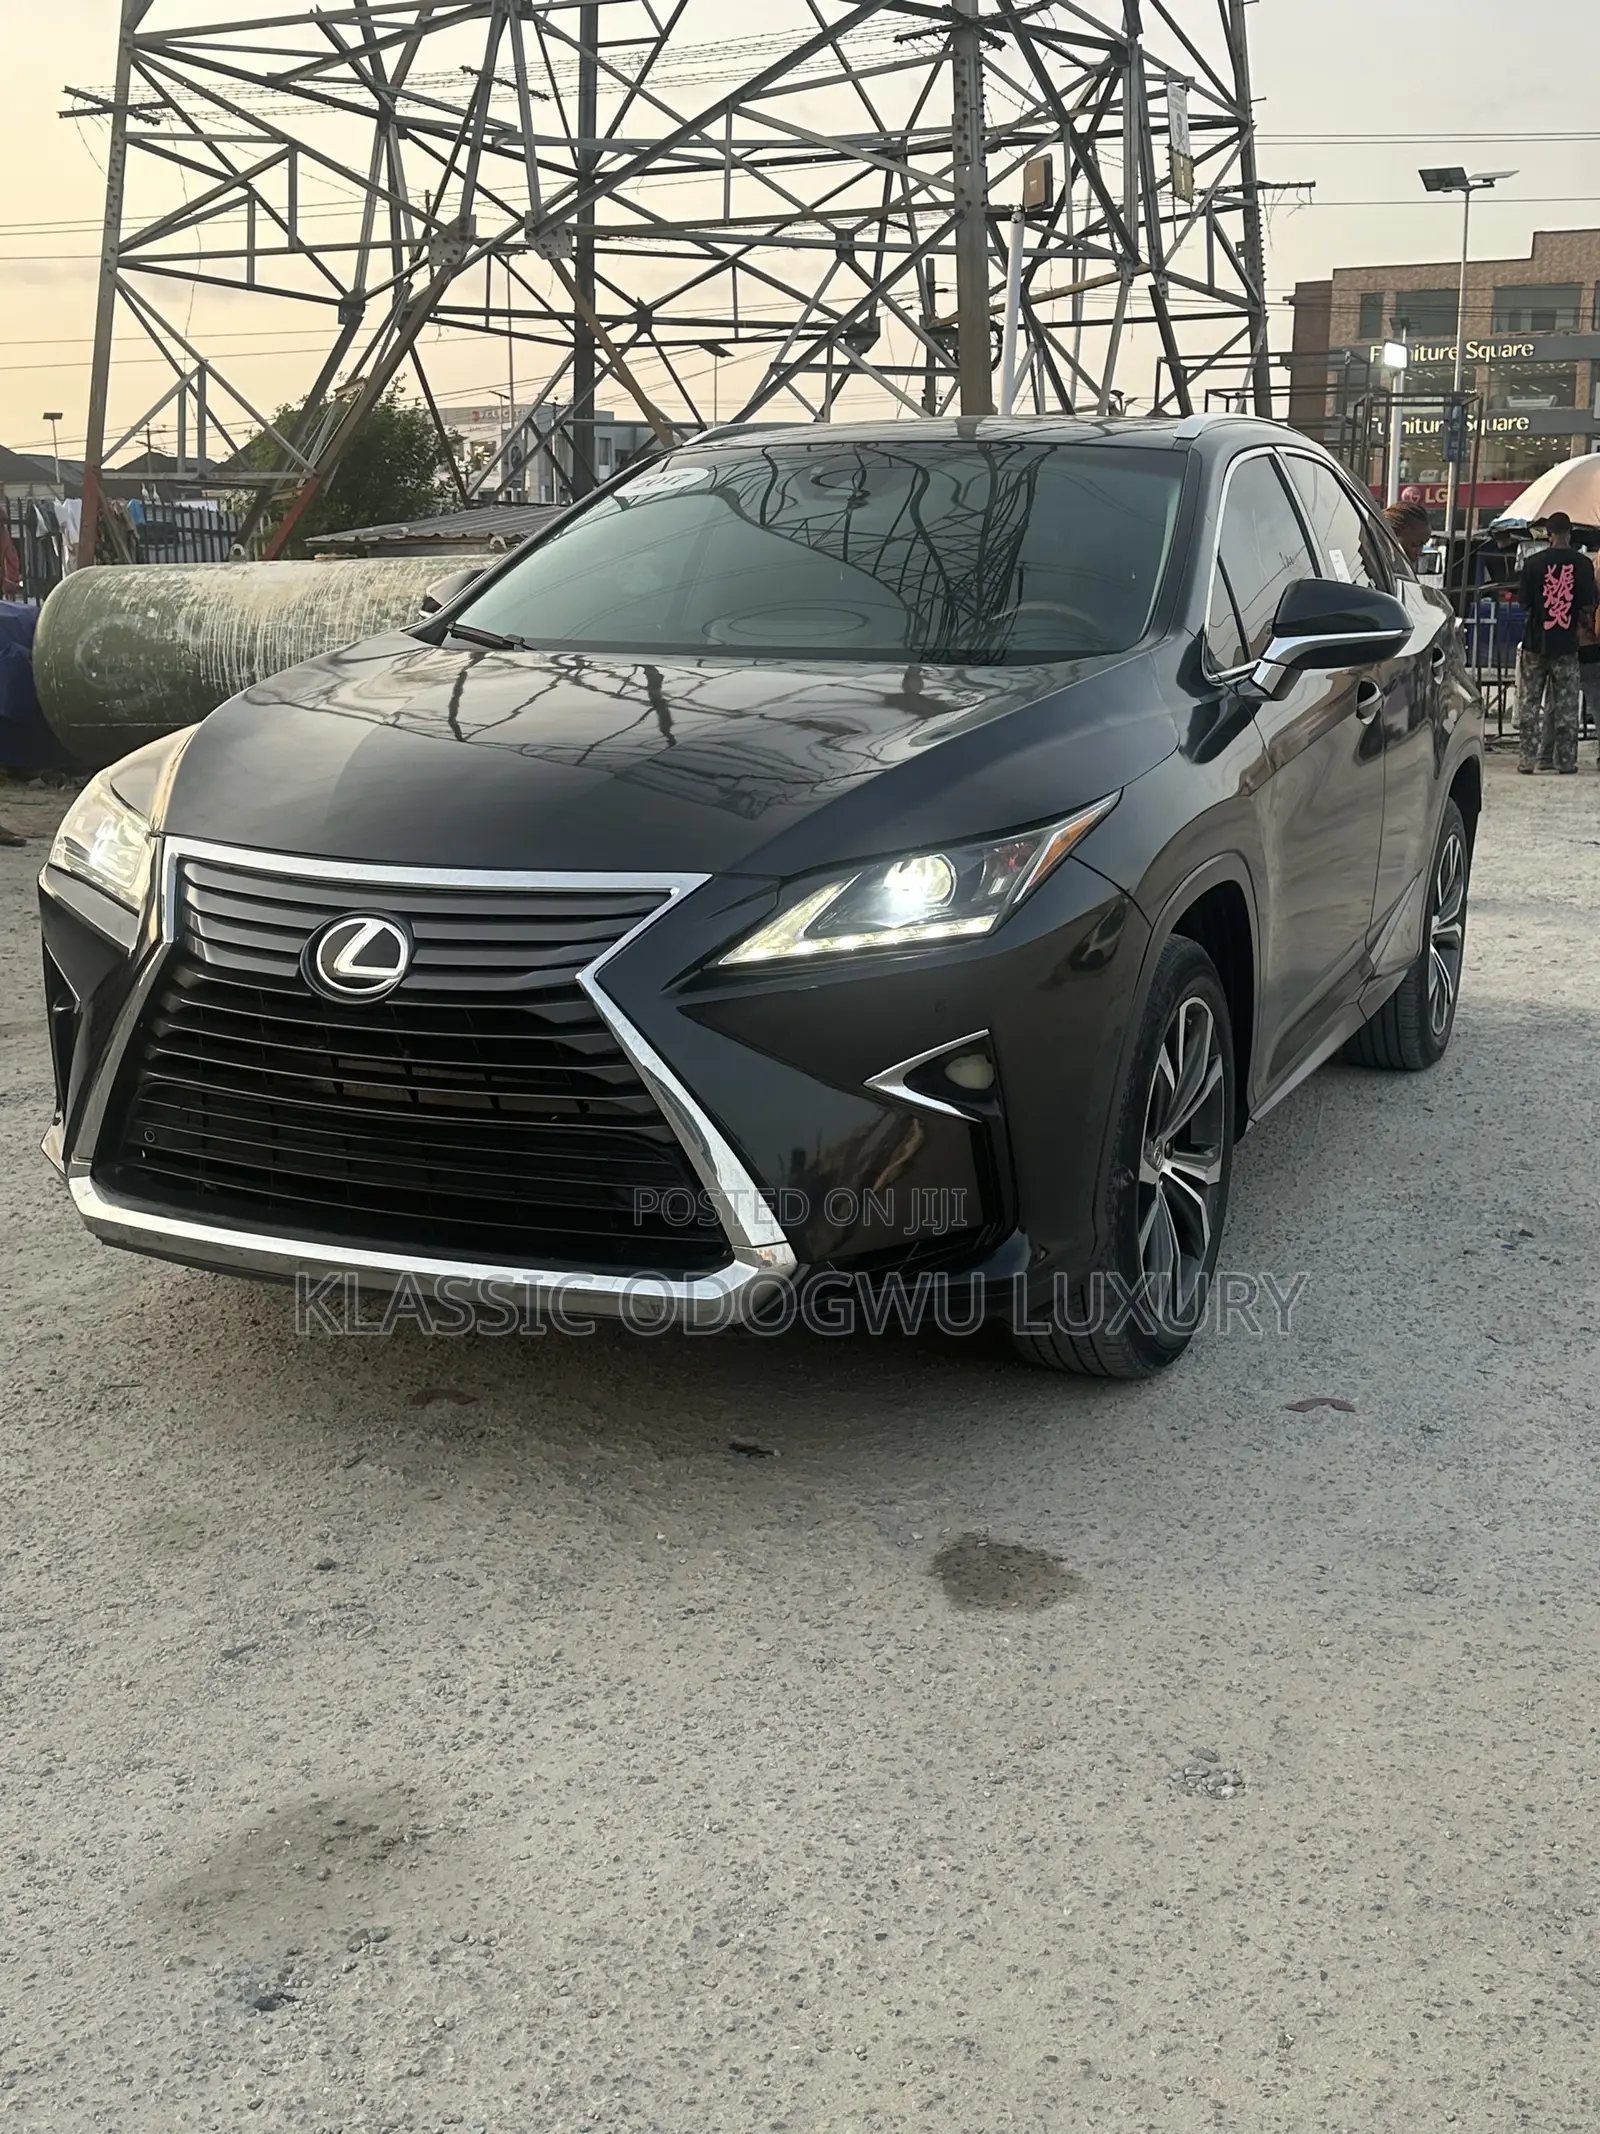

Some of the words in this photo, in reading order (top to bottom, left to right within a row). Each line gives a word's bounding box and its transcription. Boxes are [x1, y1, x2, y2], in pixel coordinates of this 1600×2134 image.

[1369, 344, 1458, 363] Fiture
[1465, 341, 1534, 363] Square
[1425, 488, 1448, 503] LG
